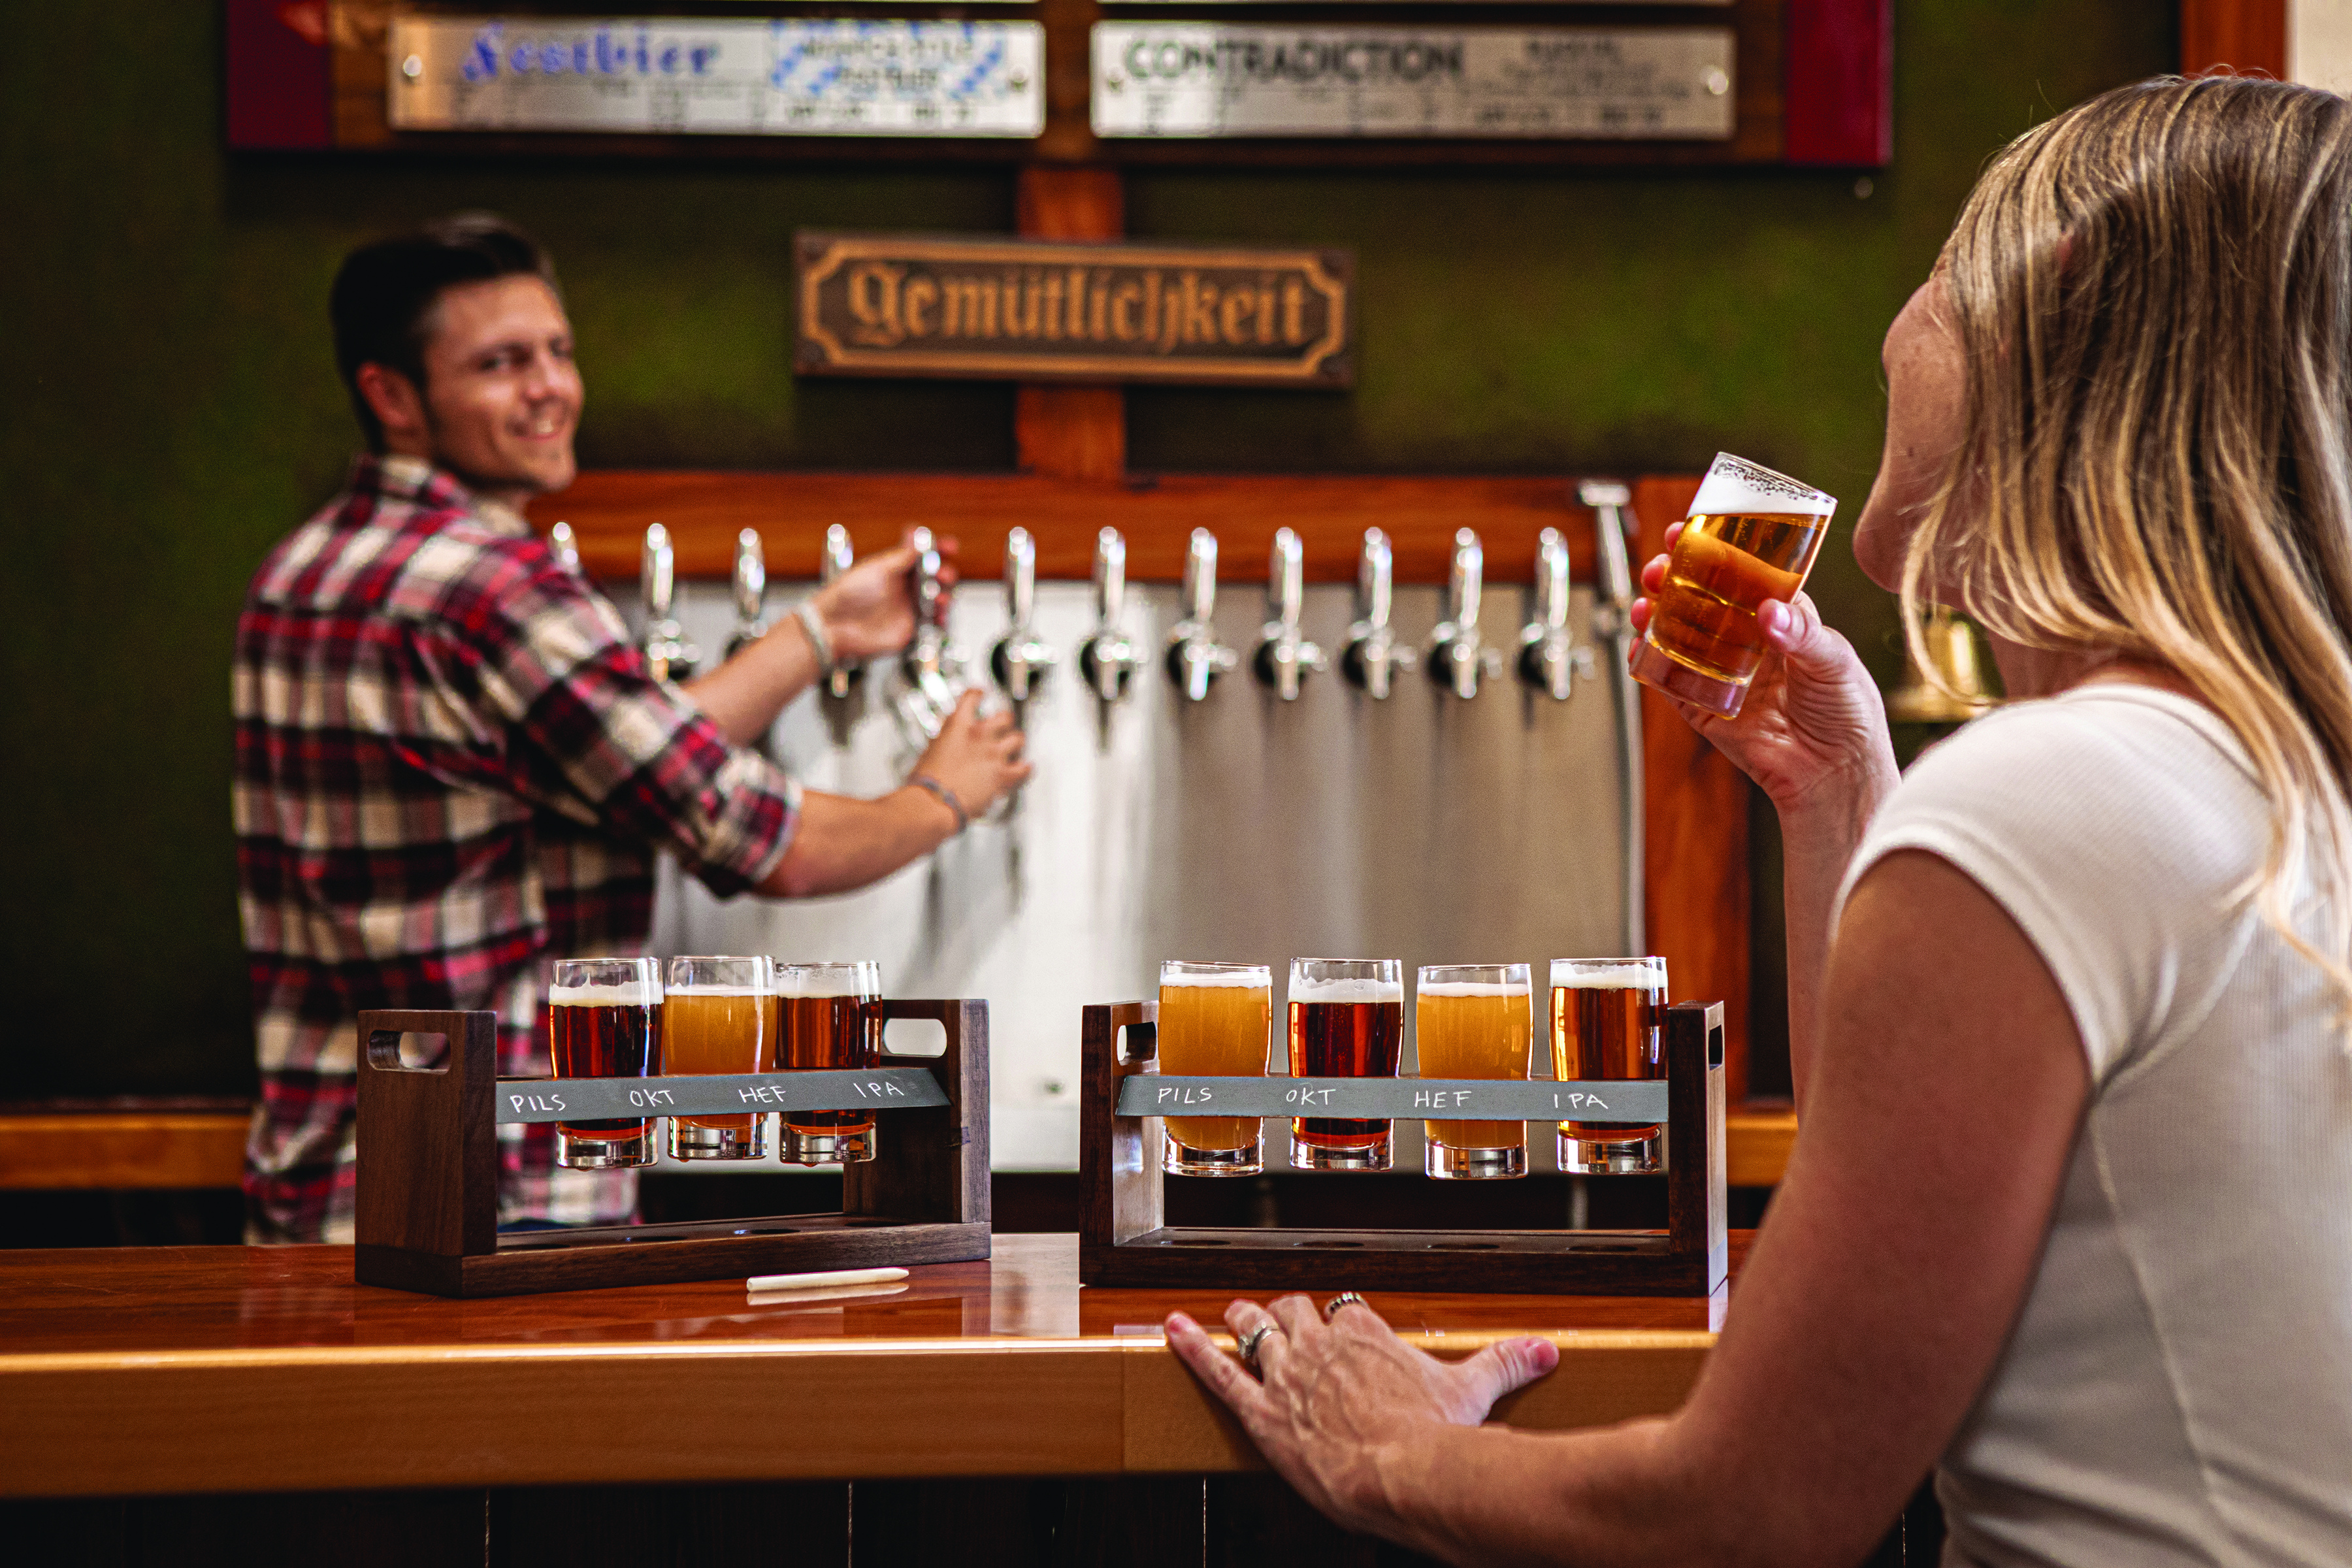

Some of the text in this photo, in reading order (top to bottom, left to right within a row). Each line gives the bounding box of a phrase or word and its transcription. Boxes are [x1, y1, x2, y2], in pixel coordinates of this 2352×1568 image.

[1124, 38, 1463, 84] CONTRADICTION
[847, 263, 1305, 355] Gemütlichkeit
[509, 1081, 905, 1113] PILS OKT HEF IPA
[1157, 1087, 1609, 1110] PILS OKT HEF IPA
